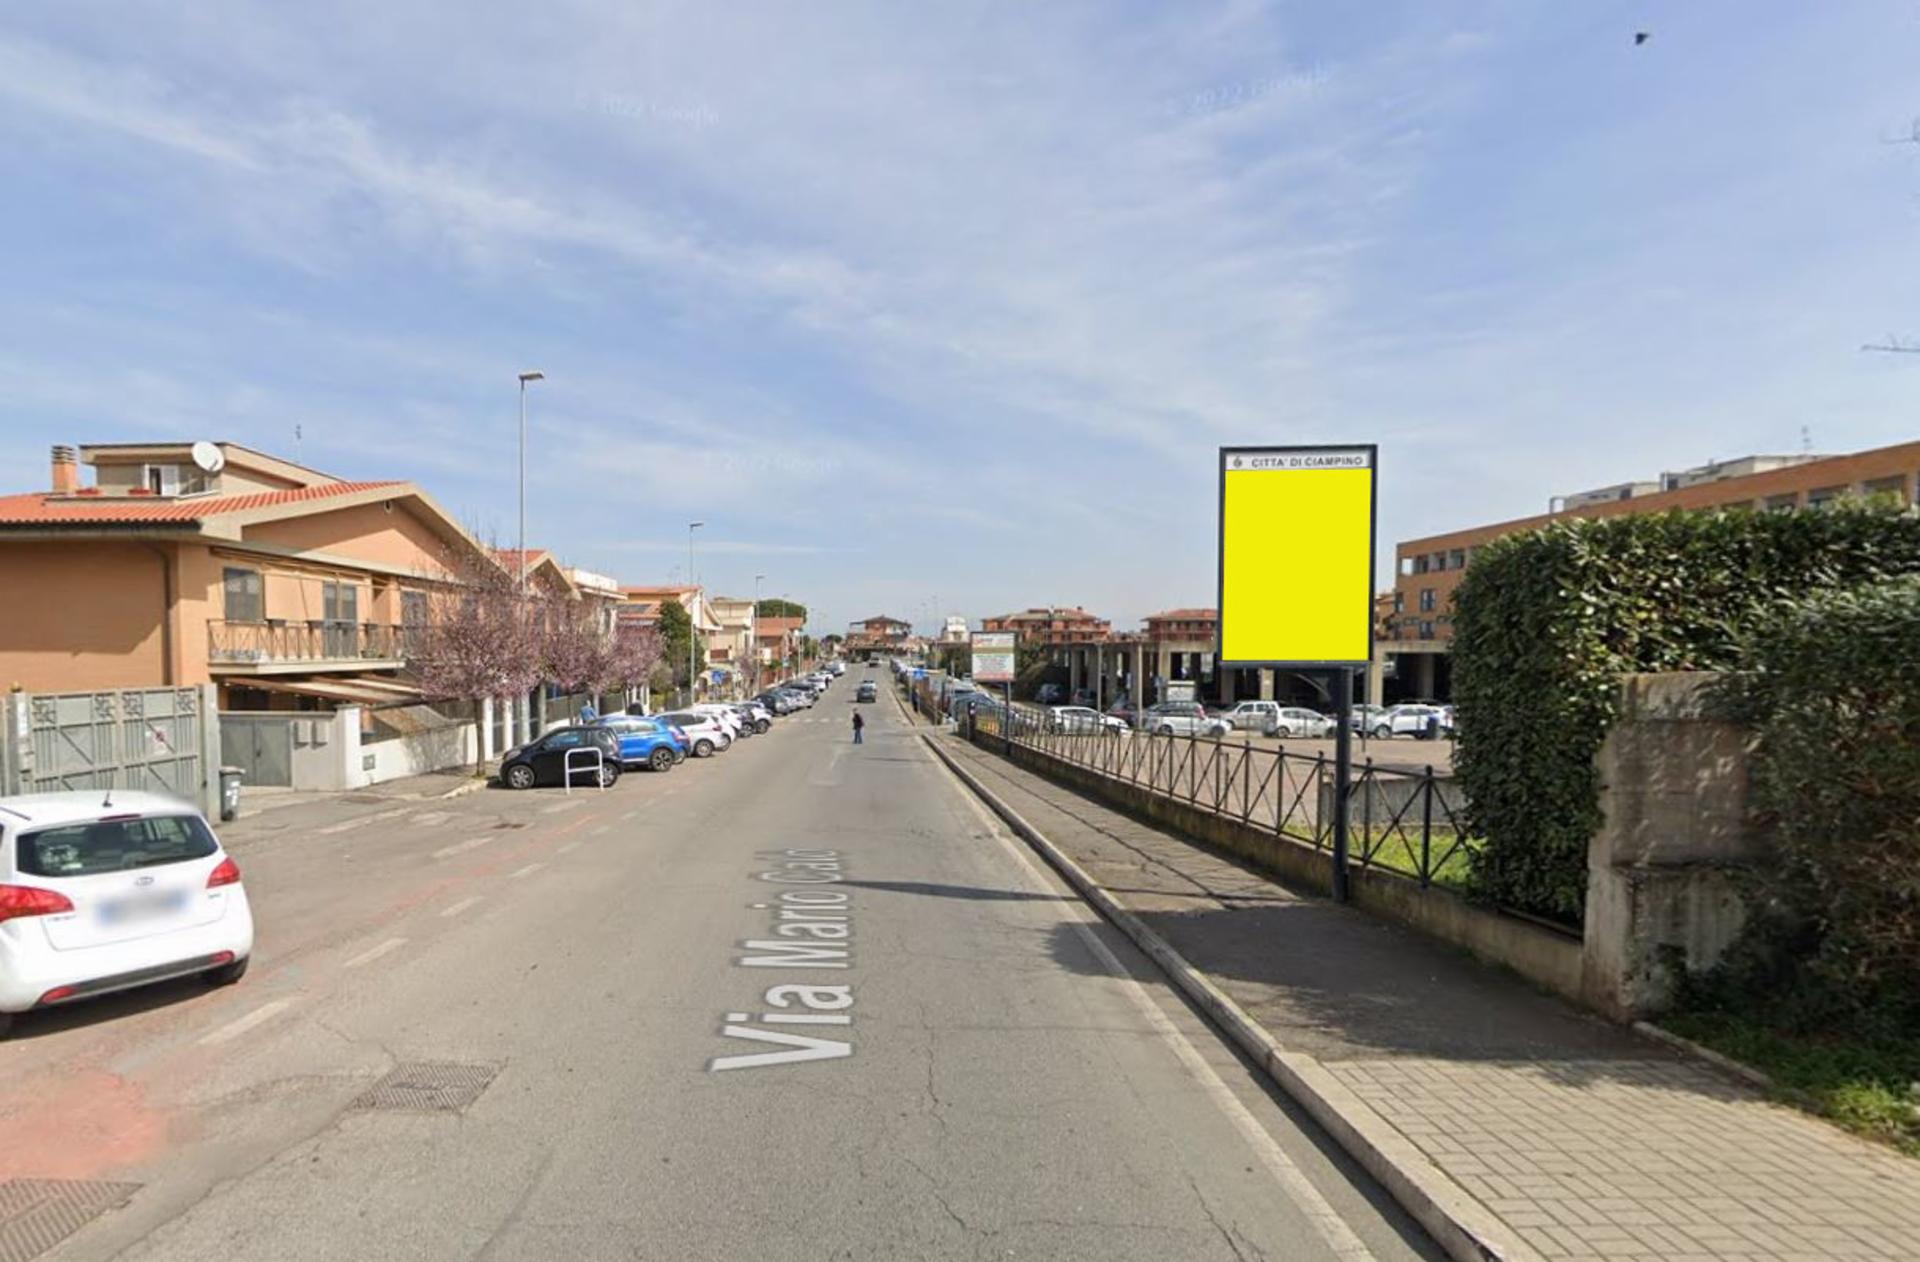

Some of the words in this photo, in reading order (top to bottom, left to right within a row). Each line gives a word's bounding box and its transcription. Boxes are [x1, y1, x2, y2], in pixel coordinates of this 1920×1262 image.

[1251, 457, 1288, 468] CITTA'
[1290, 457, 1303, 467] DI
[1305, 455, 1363, 467] CIAMPINO
